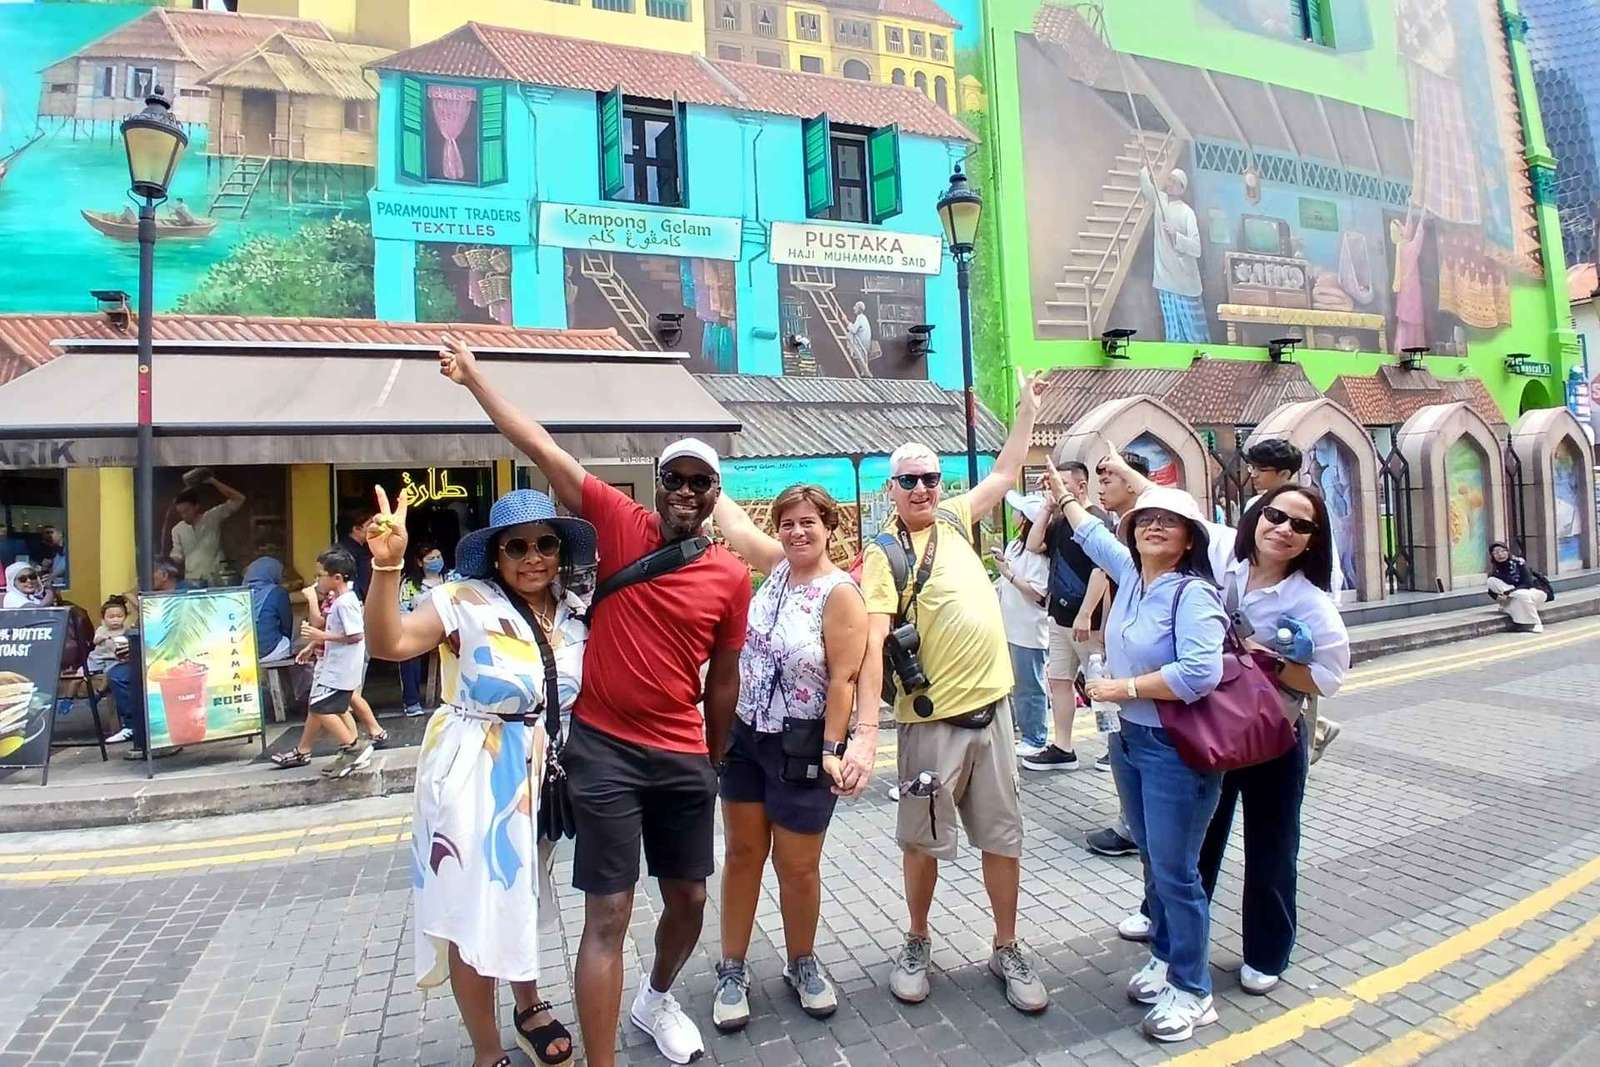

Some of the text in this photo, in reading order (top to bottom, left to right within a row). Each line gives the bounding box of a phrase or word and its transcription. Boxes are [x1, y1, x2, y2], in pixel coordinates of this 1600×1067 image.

[376, 201, 521, 223] PARAMOUNT TRADERS
[412, 221, 496, 237] TEXTILES
[564, 208, 712, 237] Kampong Gelam
[805, 231, 904, 254] PUSTAKA
[788, 248, 927, 268] HAJI MUHAMMAD SAID
[12, 627, 53, 641] BUTTER
[213, 693, 254, 707] ROSE
